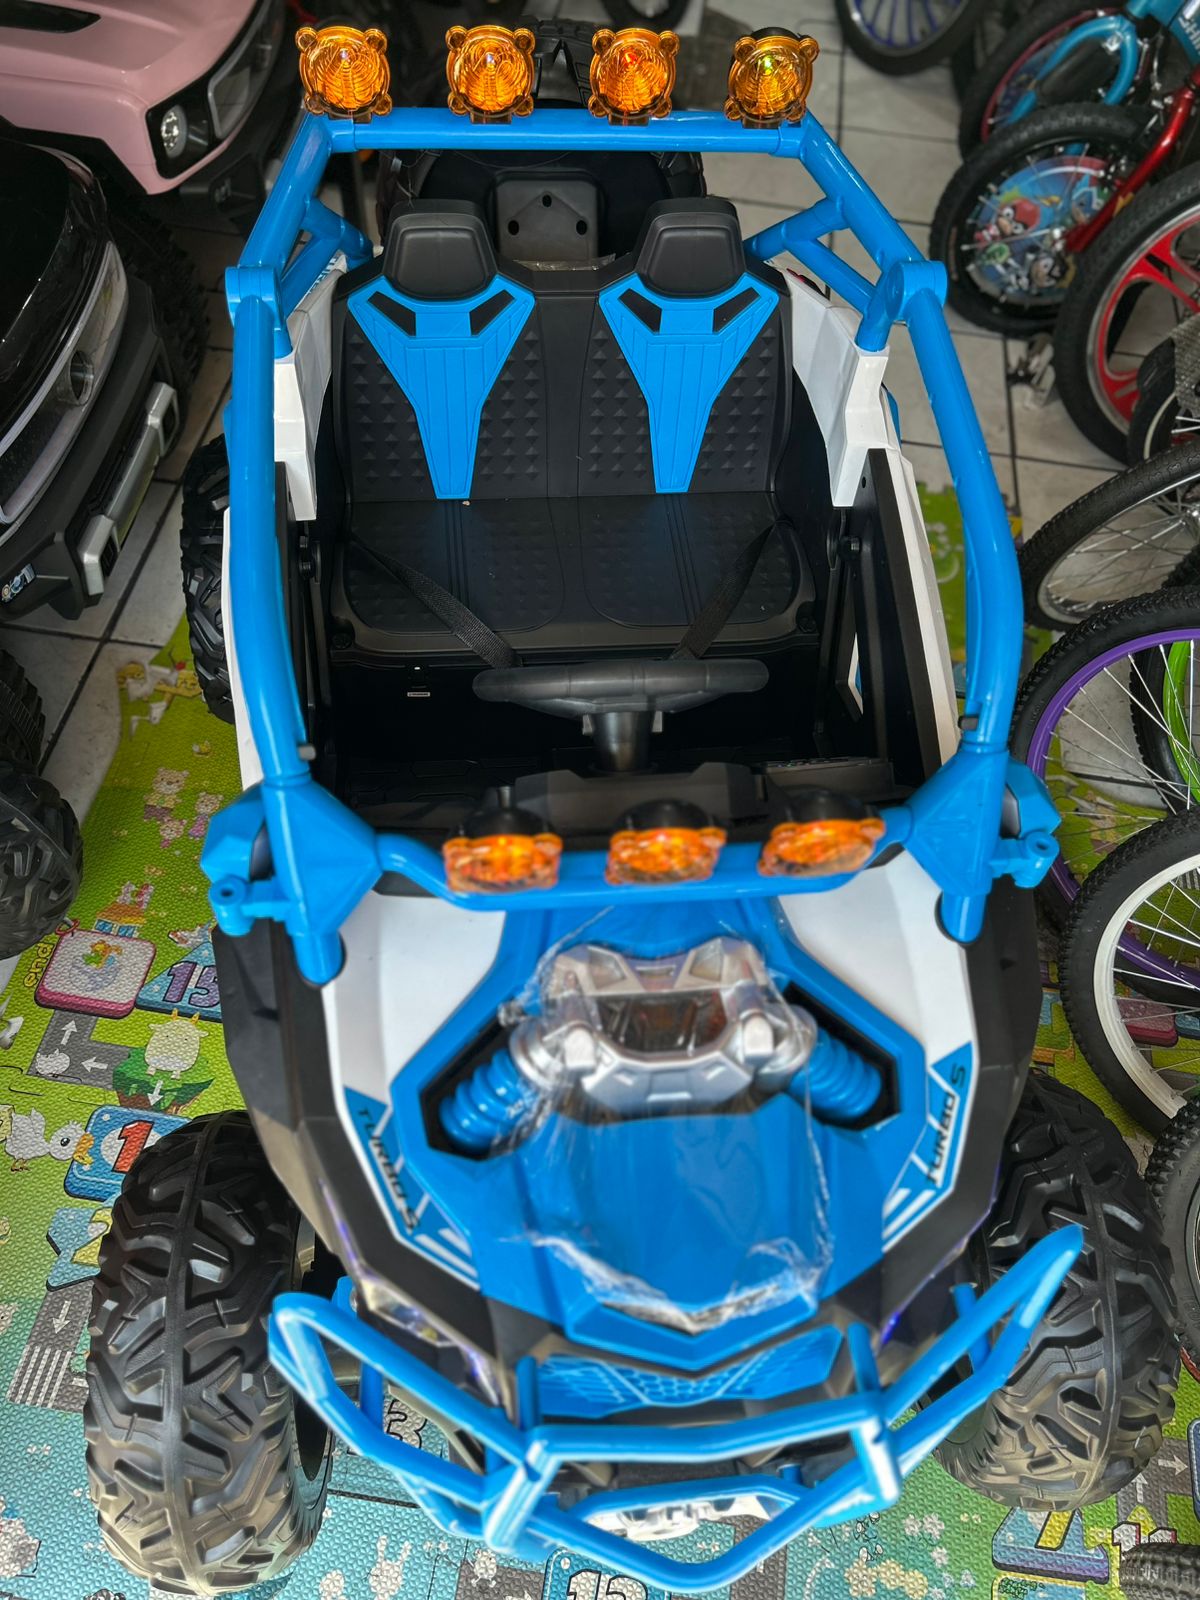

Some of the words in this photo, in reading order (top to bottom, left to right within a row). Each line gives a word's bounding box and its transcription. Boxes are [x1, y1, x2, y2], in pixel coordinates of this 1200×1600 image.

[23, 941, 55, 988] end
[162, 960, 220, 1008] 15
[111, 1119, 155, 1174] 1
[927, 1090, 956, 1185] TURBO
[950, 1062, 966, 1089] S
[357, 1105, 407, 1199] TURBO
[400, 1206, 422, 1231] S
